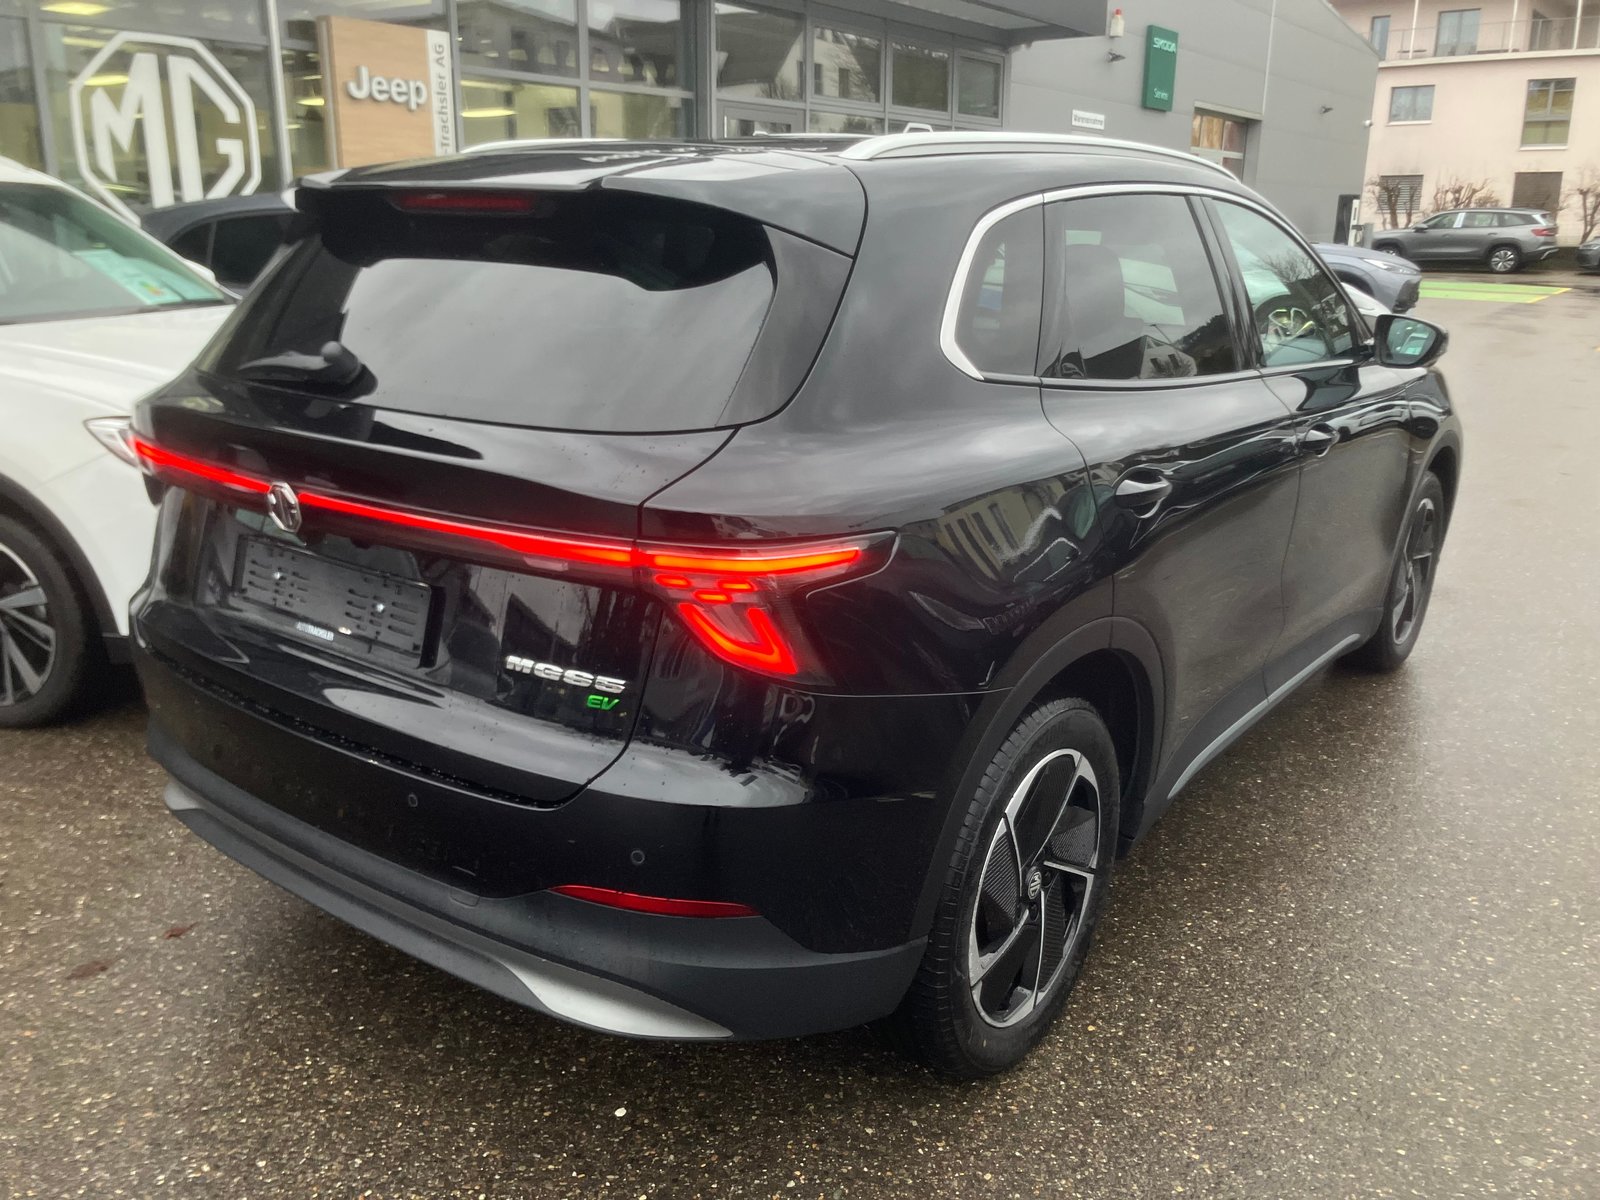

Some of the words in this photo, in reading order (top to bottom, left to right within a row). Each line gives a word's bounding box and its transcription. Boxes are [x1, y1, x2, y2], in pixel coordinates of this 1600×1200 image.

[434, 44, 446, 68] AG
[346, 64, 428, 111] Jeep
[89, 51, 246, 209] MG
[505, 655, 626, 694] MGS5
[586, 694, 620, 711] EV
